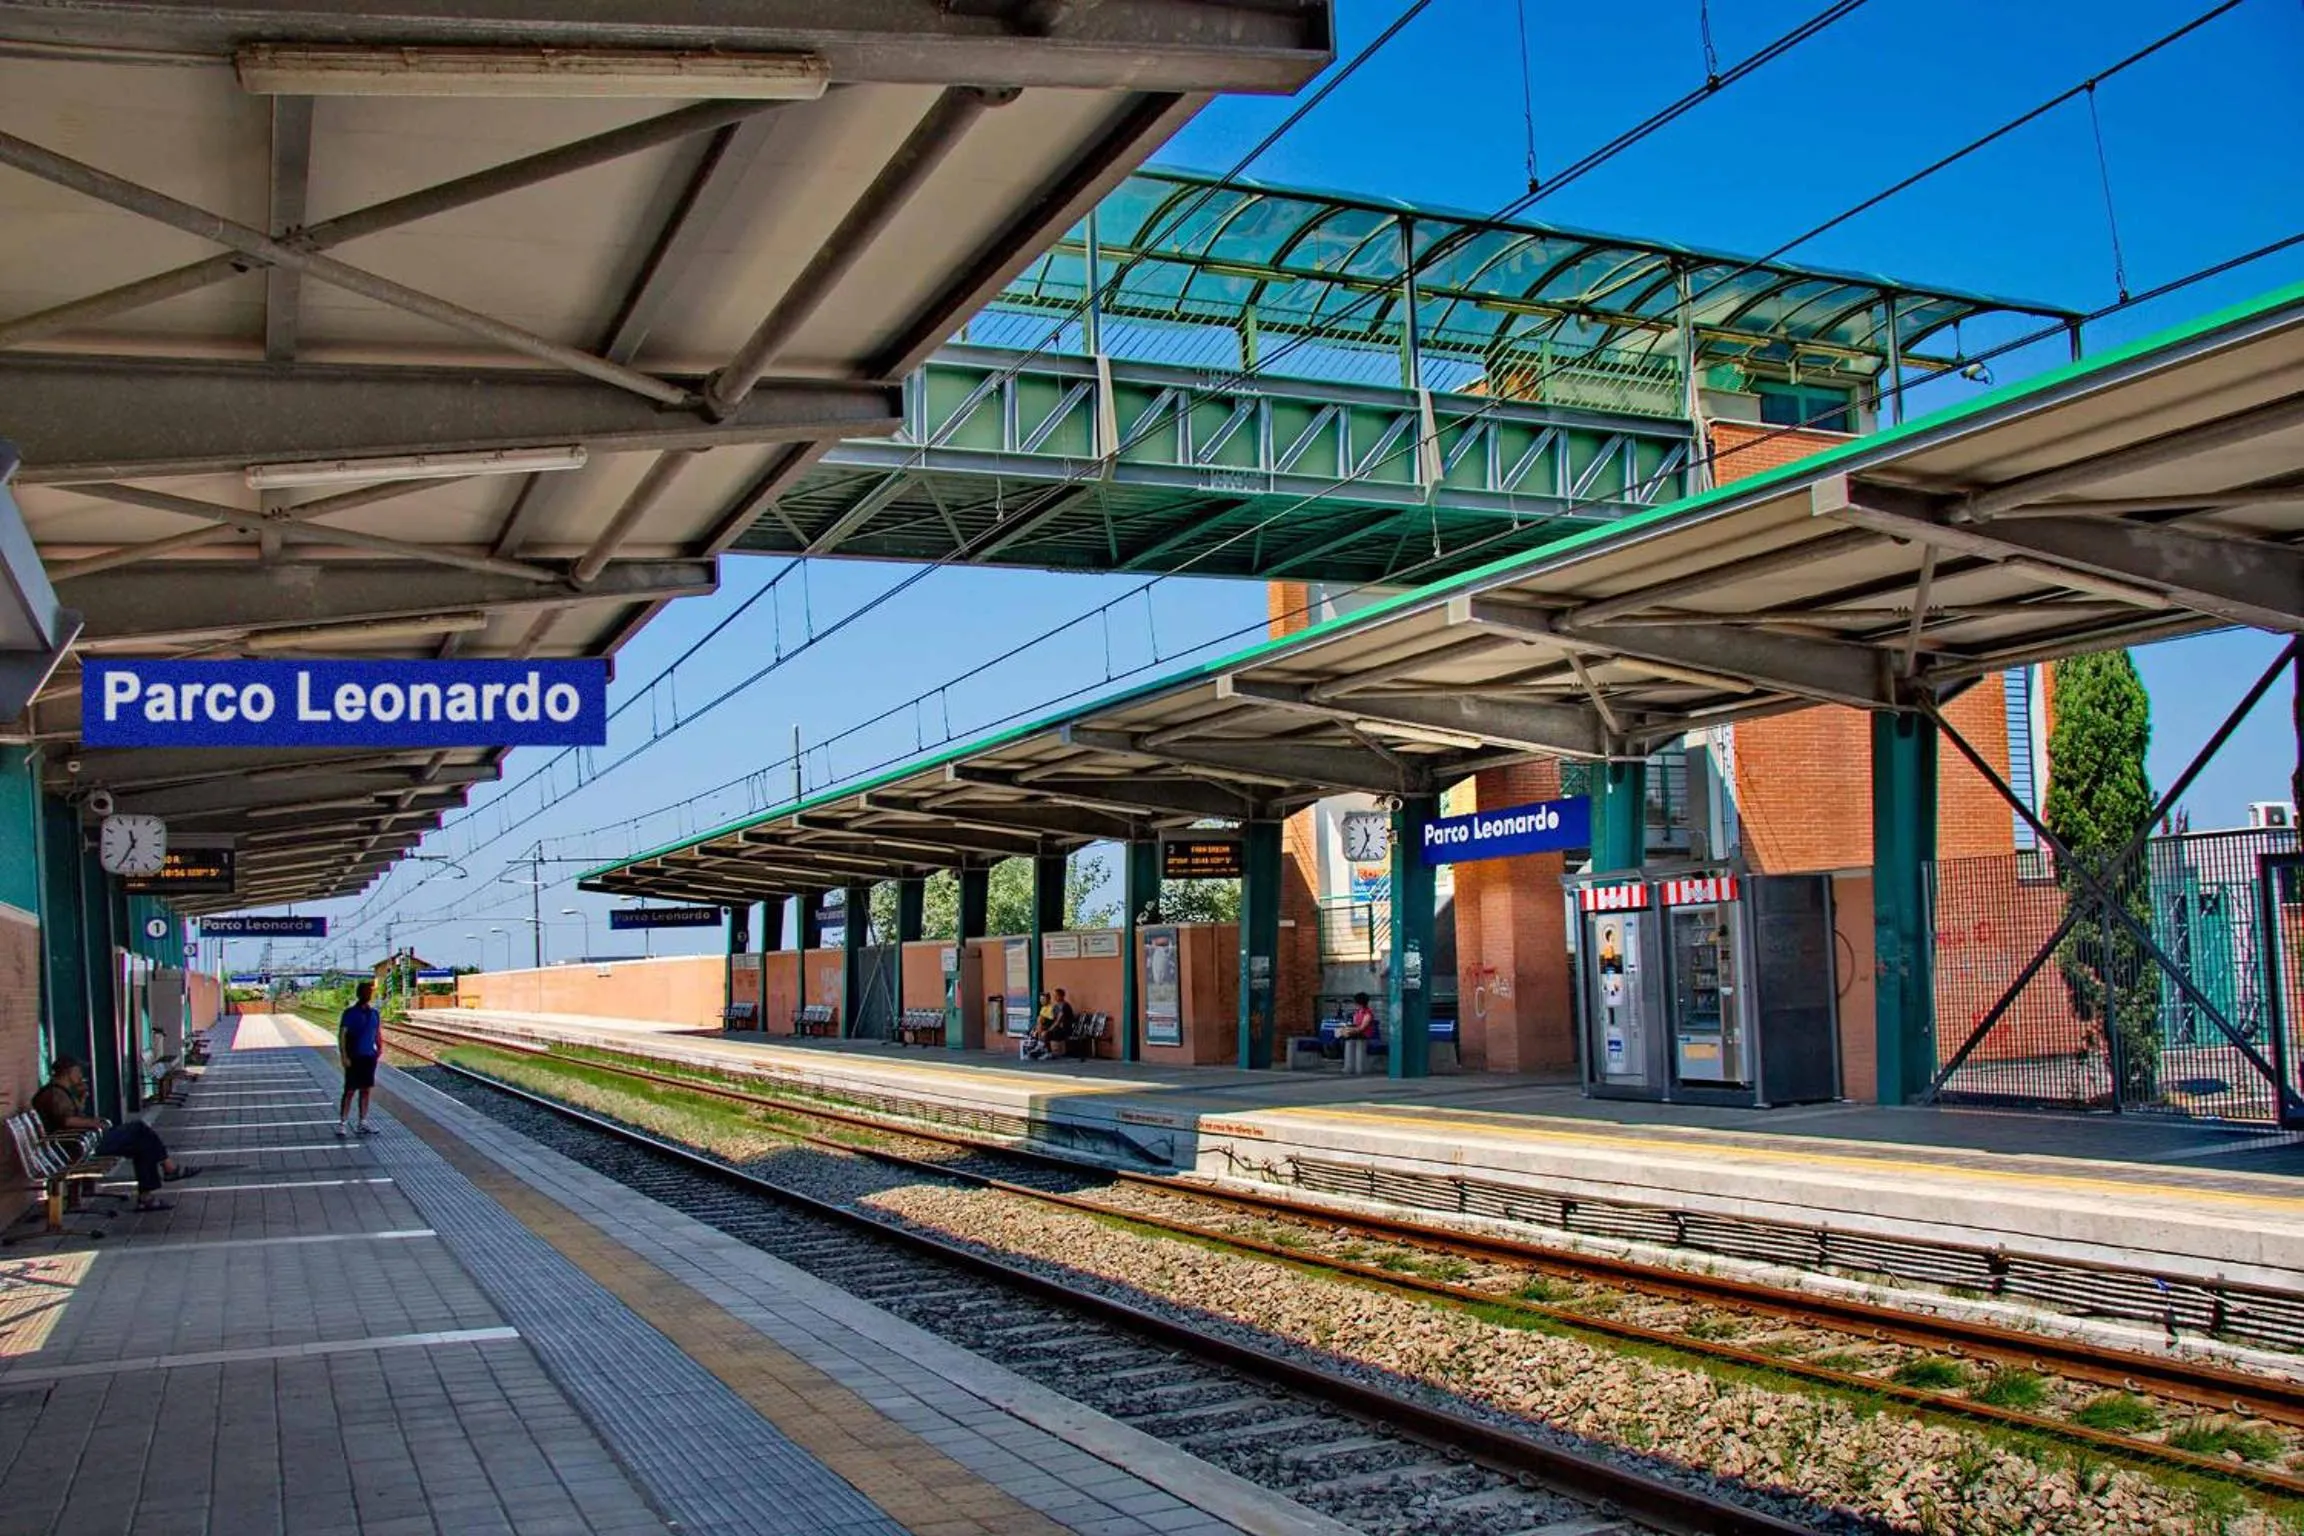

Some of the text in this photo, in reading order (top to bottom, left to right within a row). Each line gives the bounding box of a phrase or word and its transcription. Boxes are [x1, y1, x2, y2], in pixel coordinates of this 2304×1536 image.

[104, 671, 581, 723] Parco Leonardo
[1424, 805, 1560, 846] Parco Leonardo
[652, 909, 711, 921] Leonardo
[153, 921, 162, 935] 1
[202, 919, 313, 930] Parco Leonardo
